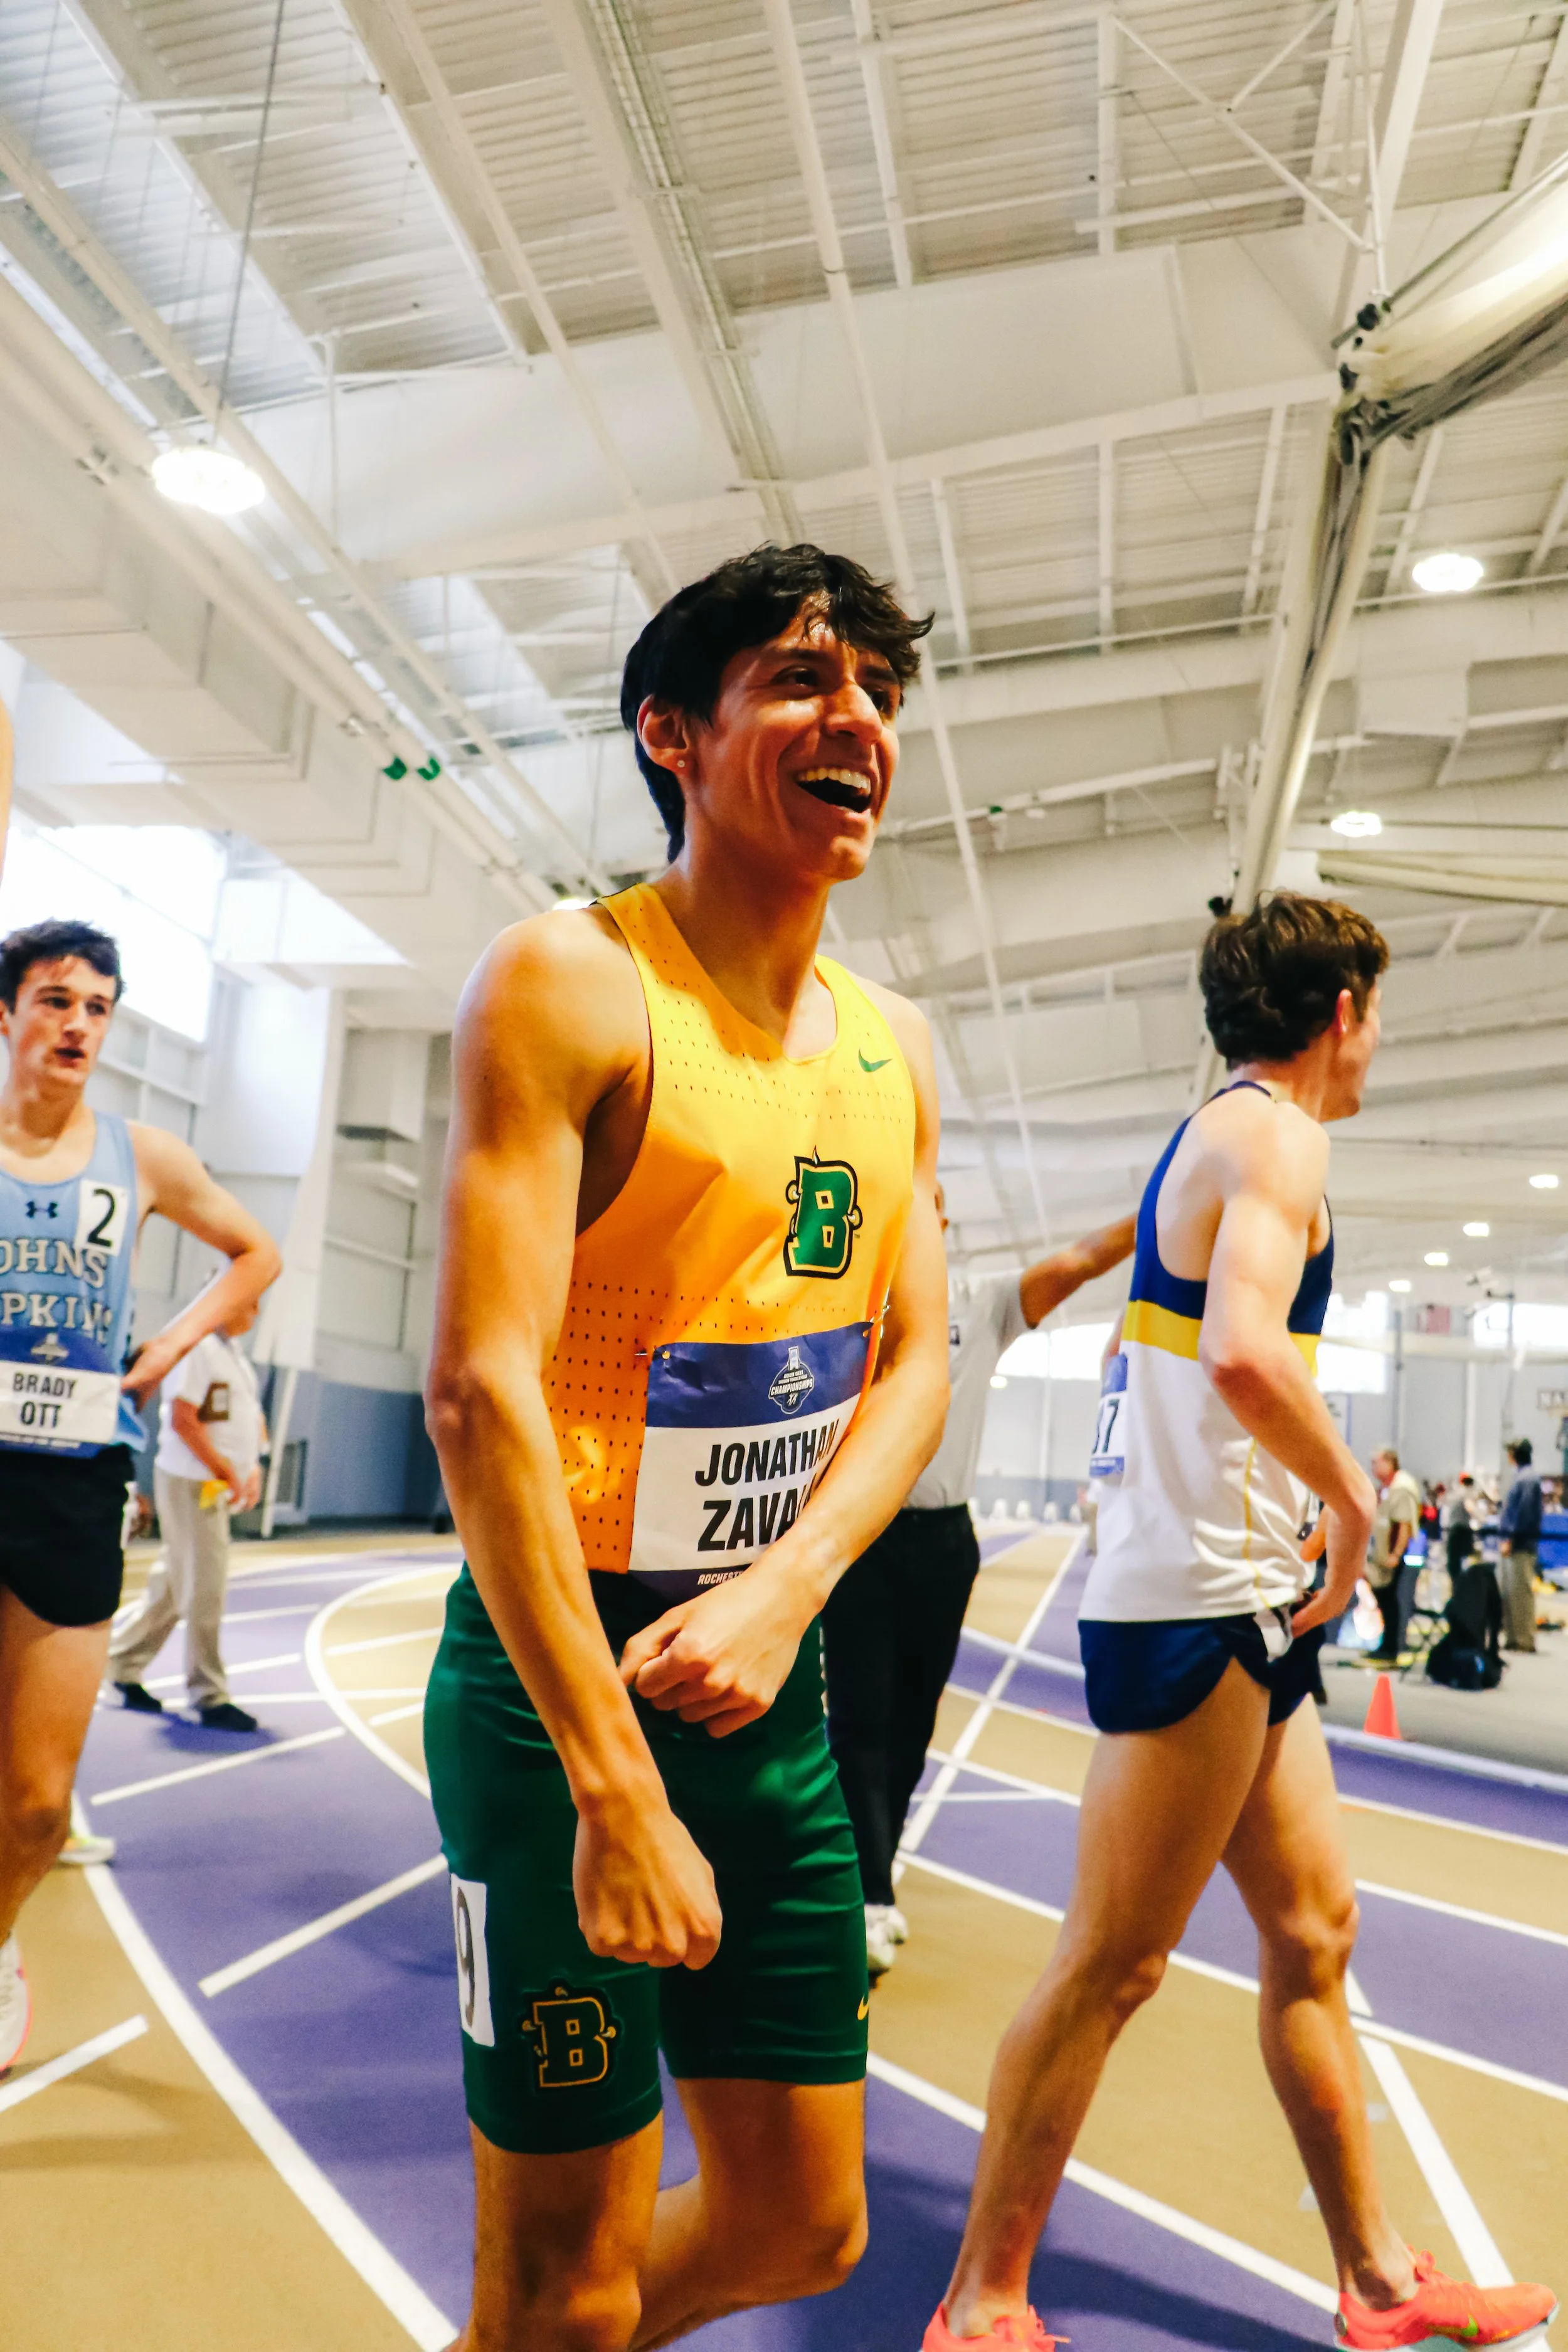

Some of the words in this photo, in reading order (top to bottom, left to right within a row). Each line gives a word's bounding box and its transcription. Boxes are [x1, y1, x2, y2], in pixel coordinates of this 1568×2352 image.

[87, 1188, 115, 1248] 2
[13, 1372, 78, 1399] BRADY
[770, 1378, 813, 1396] CHAMPIONSHIPS
[21, 1401, 61, 1428] OTT
[695, 1419, 840, 1486] JONATHAN
[457, 1887, 475, 2028] 9
